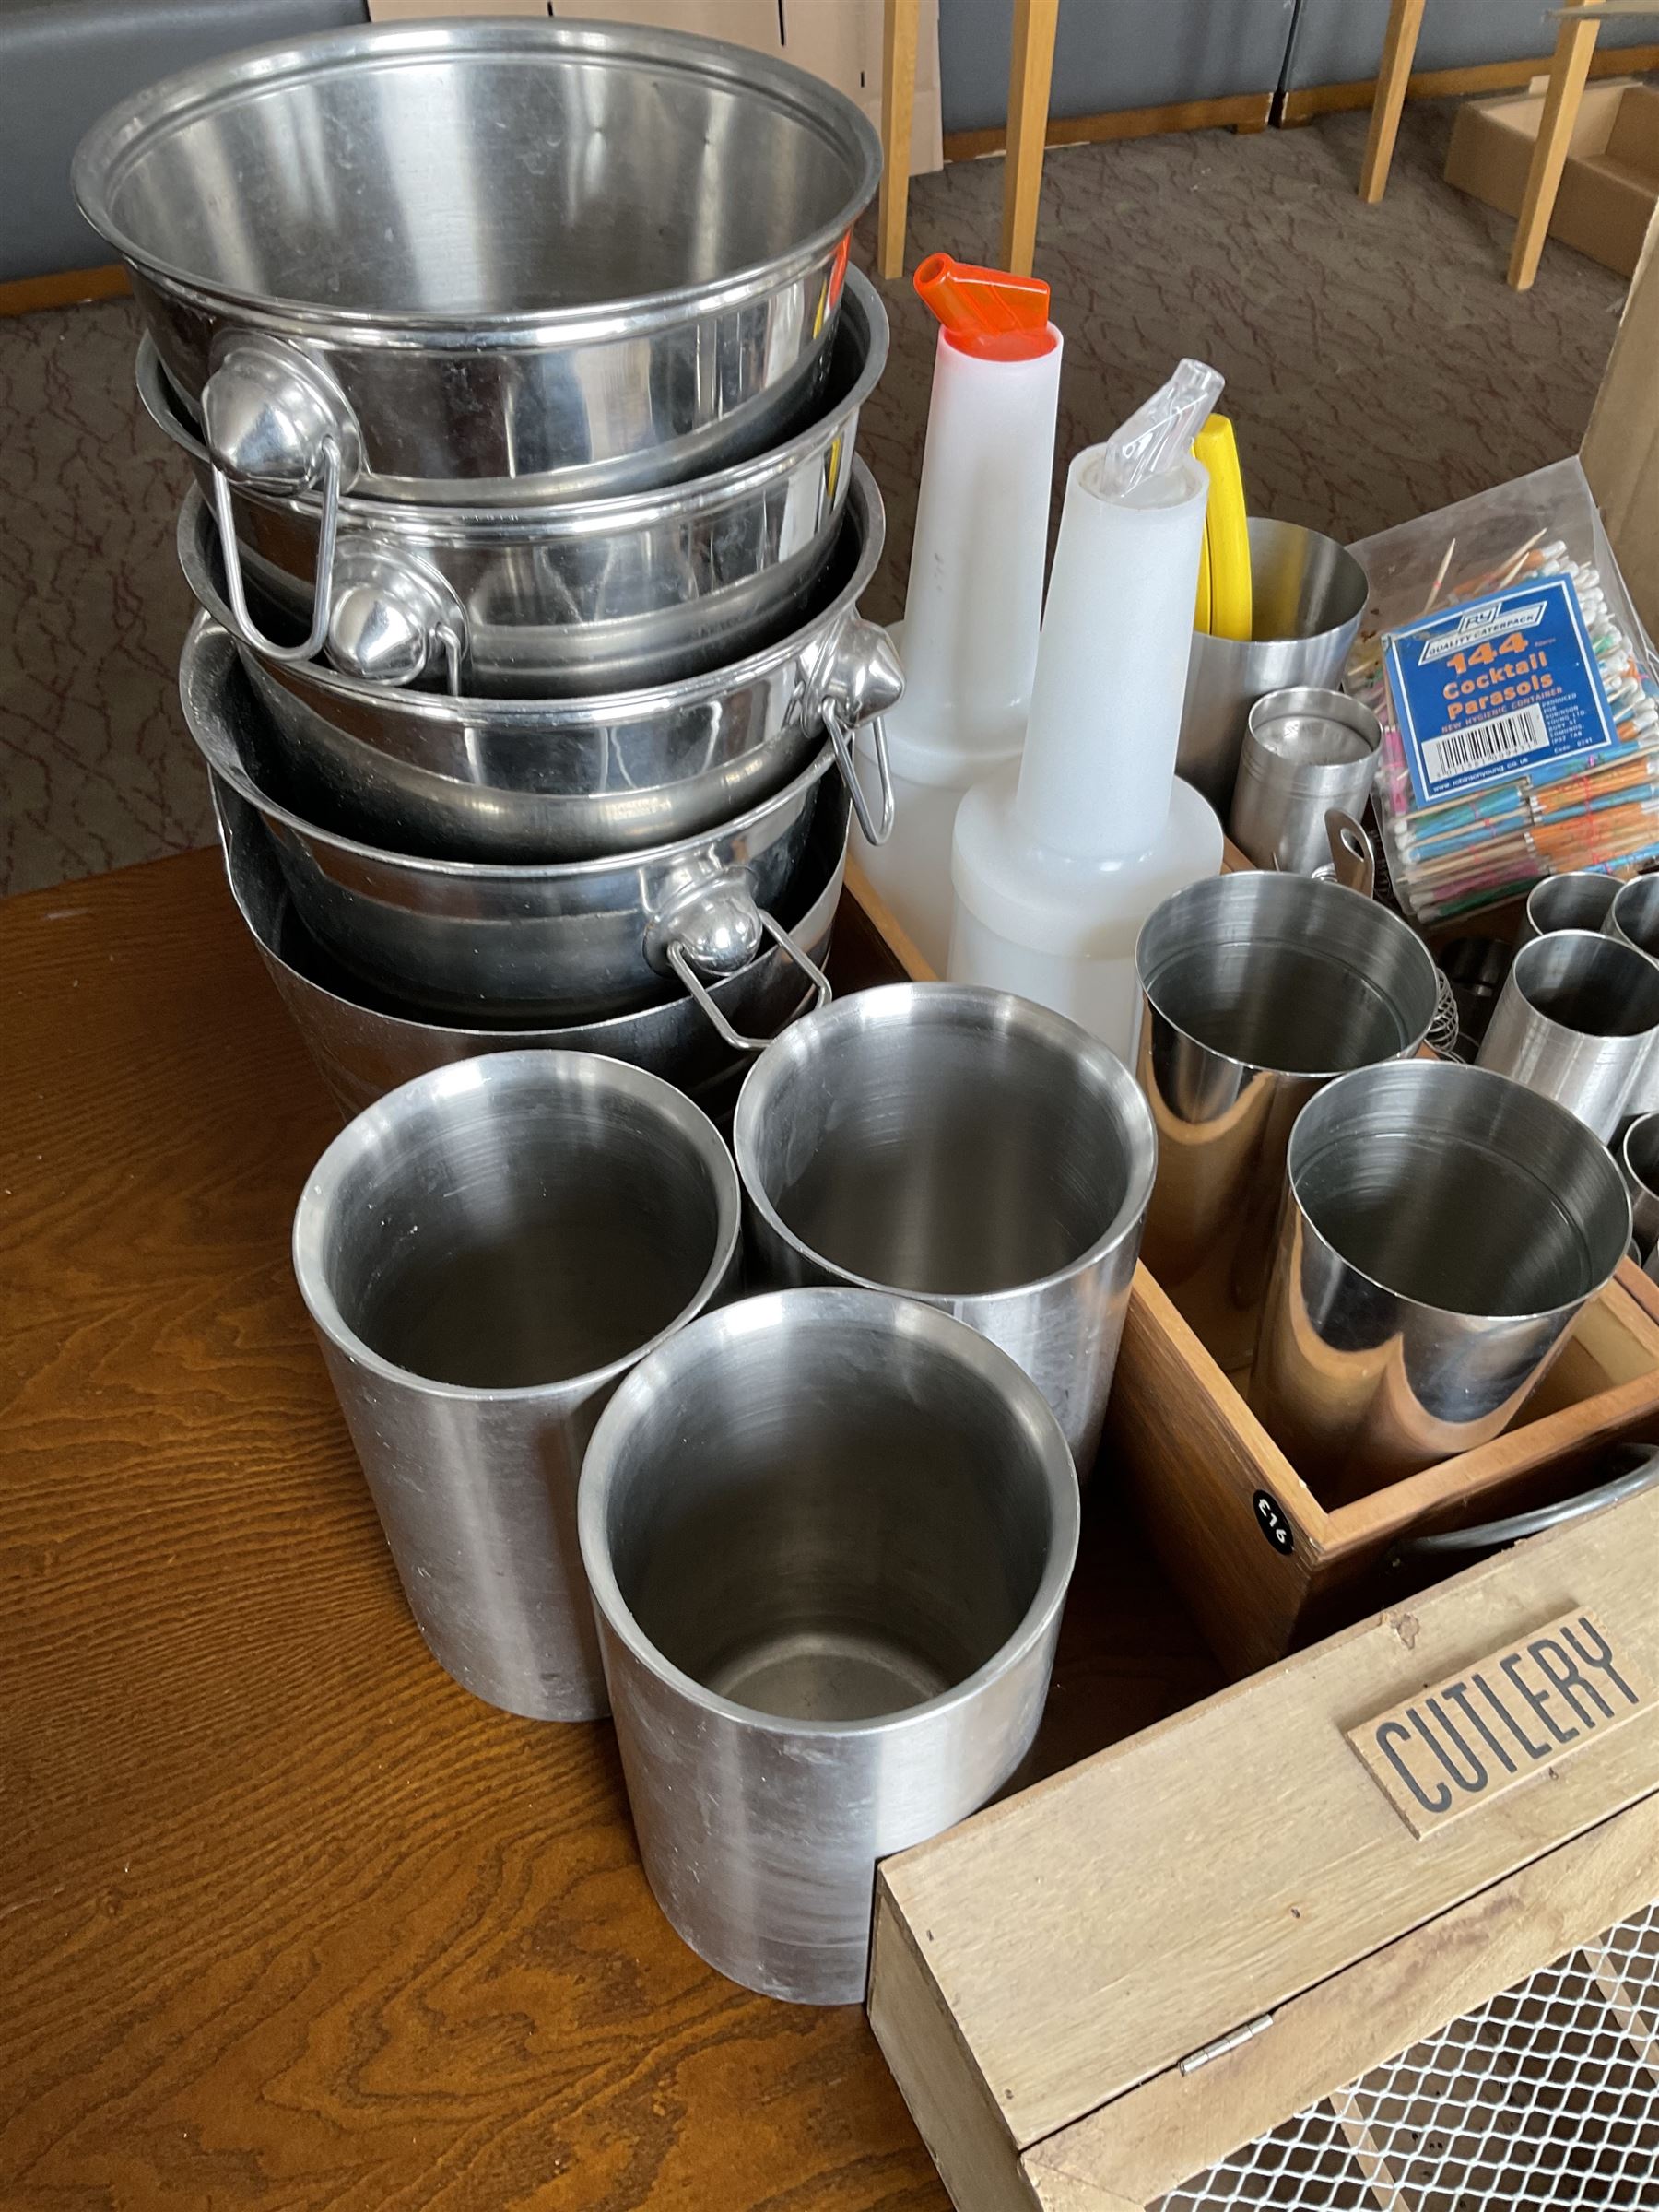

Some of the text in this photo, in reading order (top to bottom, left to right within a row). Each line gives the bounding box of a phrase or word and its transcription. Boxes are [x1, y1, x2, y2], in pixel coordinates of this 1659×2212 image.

[1429, 615, 1534, 654] QUALITY CATERPACK
[1446, 631, 1529, 675] 144
[1443, 651, 1547, 700] Cocktail
[1447, 673, 1553, 720] Parasols
[1441, 688, 1562, 734] NEW HYGIENIC CONTAINER
[1375, 1616, 1640, 1814] CUTLERY
